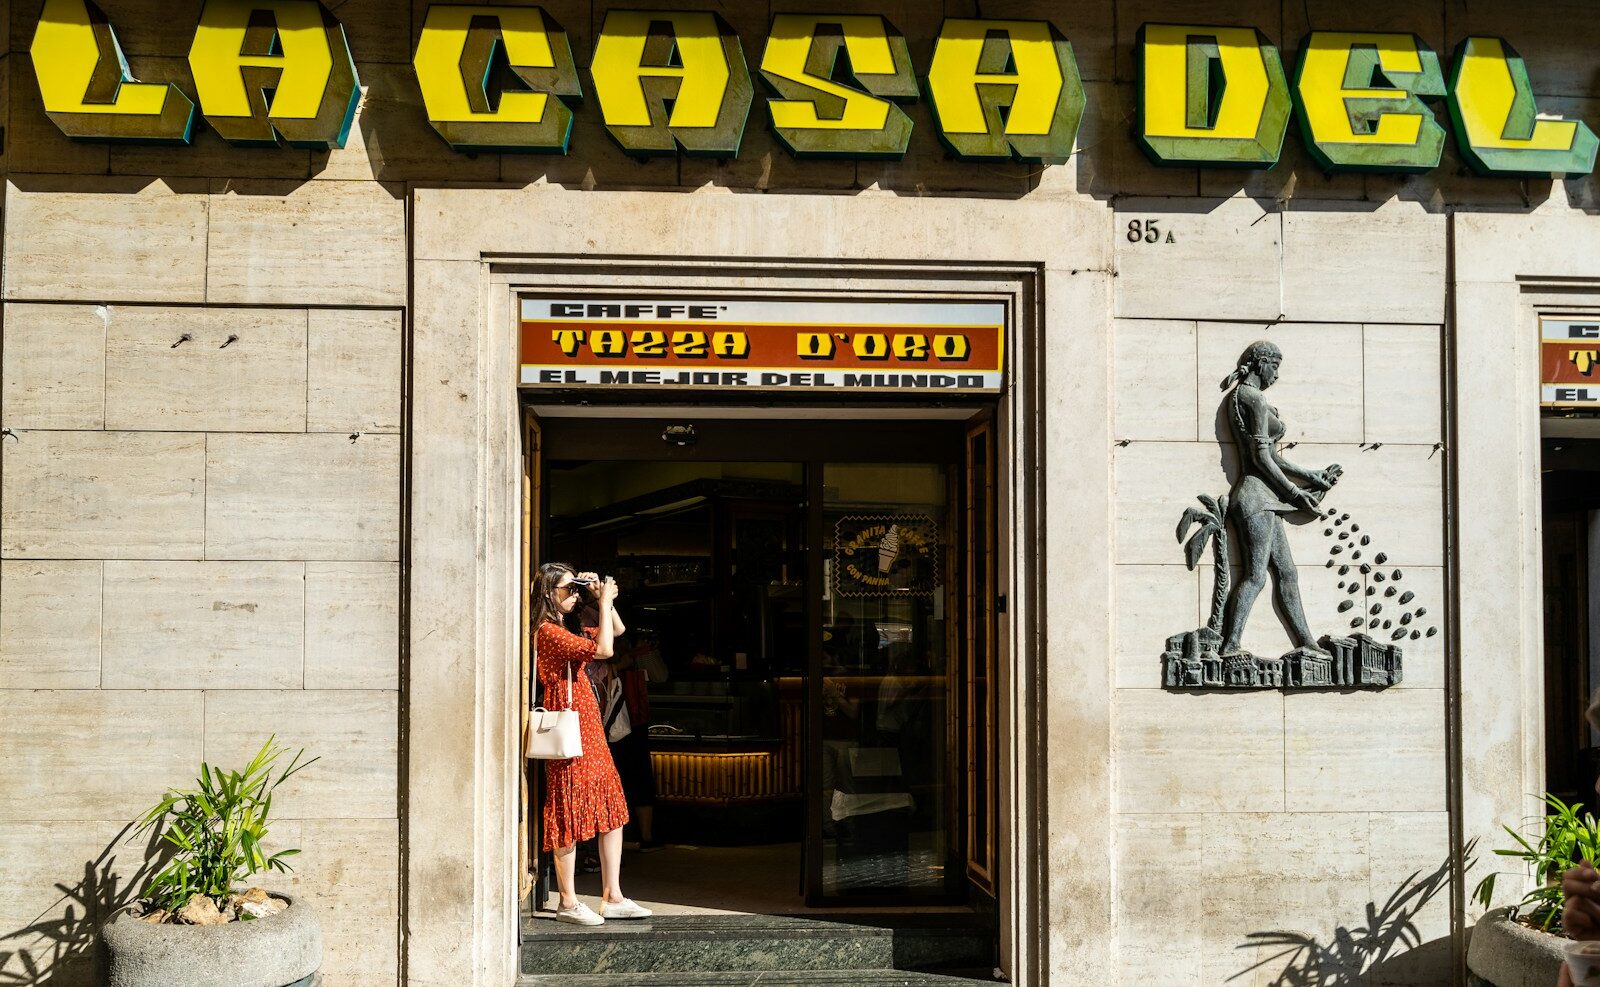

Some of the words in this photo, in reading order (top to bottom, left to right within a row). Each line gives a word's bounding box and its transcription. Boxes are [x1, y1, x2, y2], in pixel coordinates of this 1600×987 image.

[29, 0, 344, 124] LA
[413, 4, 1070, 145] CASA
[1141, 22, 1584, 158] DEL
[551, 329, 751, 359] TAZZA
[796, 332, 971, 361] D'ORO
[540, 370, 587, 384] EL
[600, 371, 748, 386] MEJOR
[760, 373, 835, 386] DEL
[844, 374, 984, 388] MUNDO
[1555, 388, 1598, 402] EL
[844, 525, 886, 556] GRANITA
[846, 564, 863, 580] CON
[862, 575, 890, 586] PANNA
